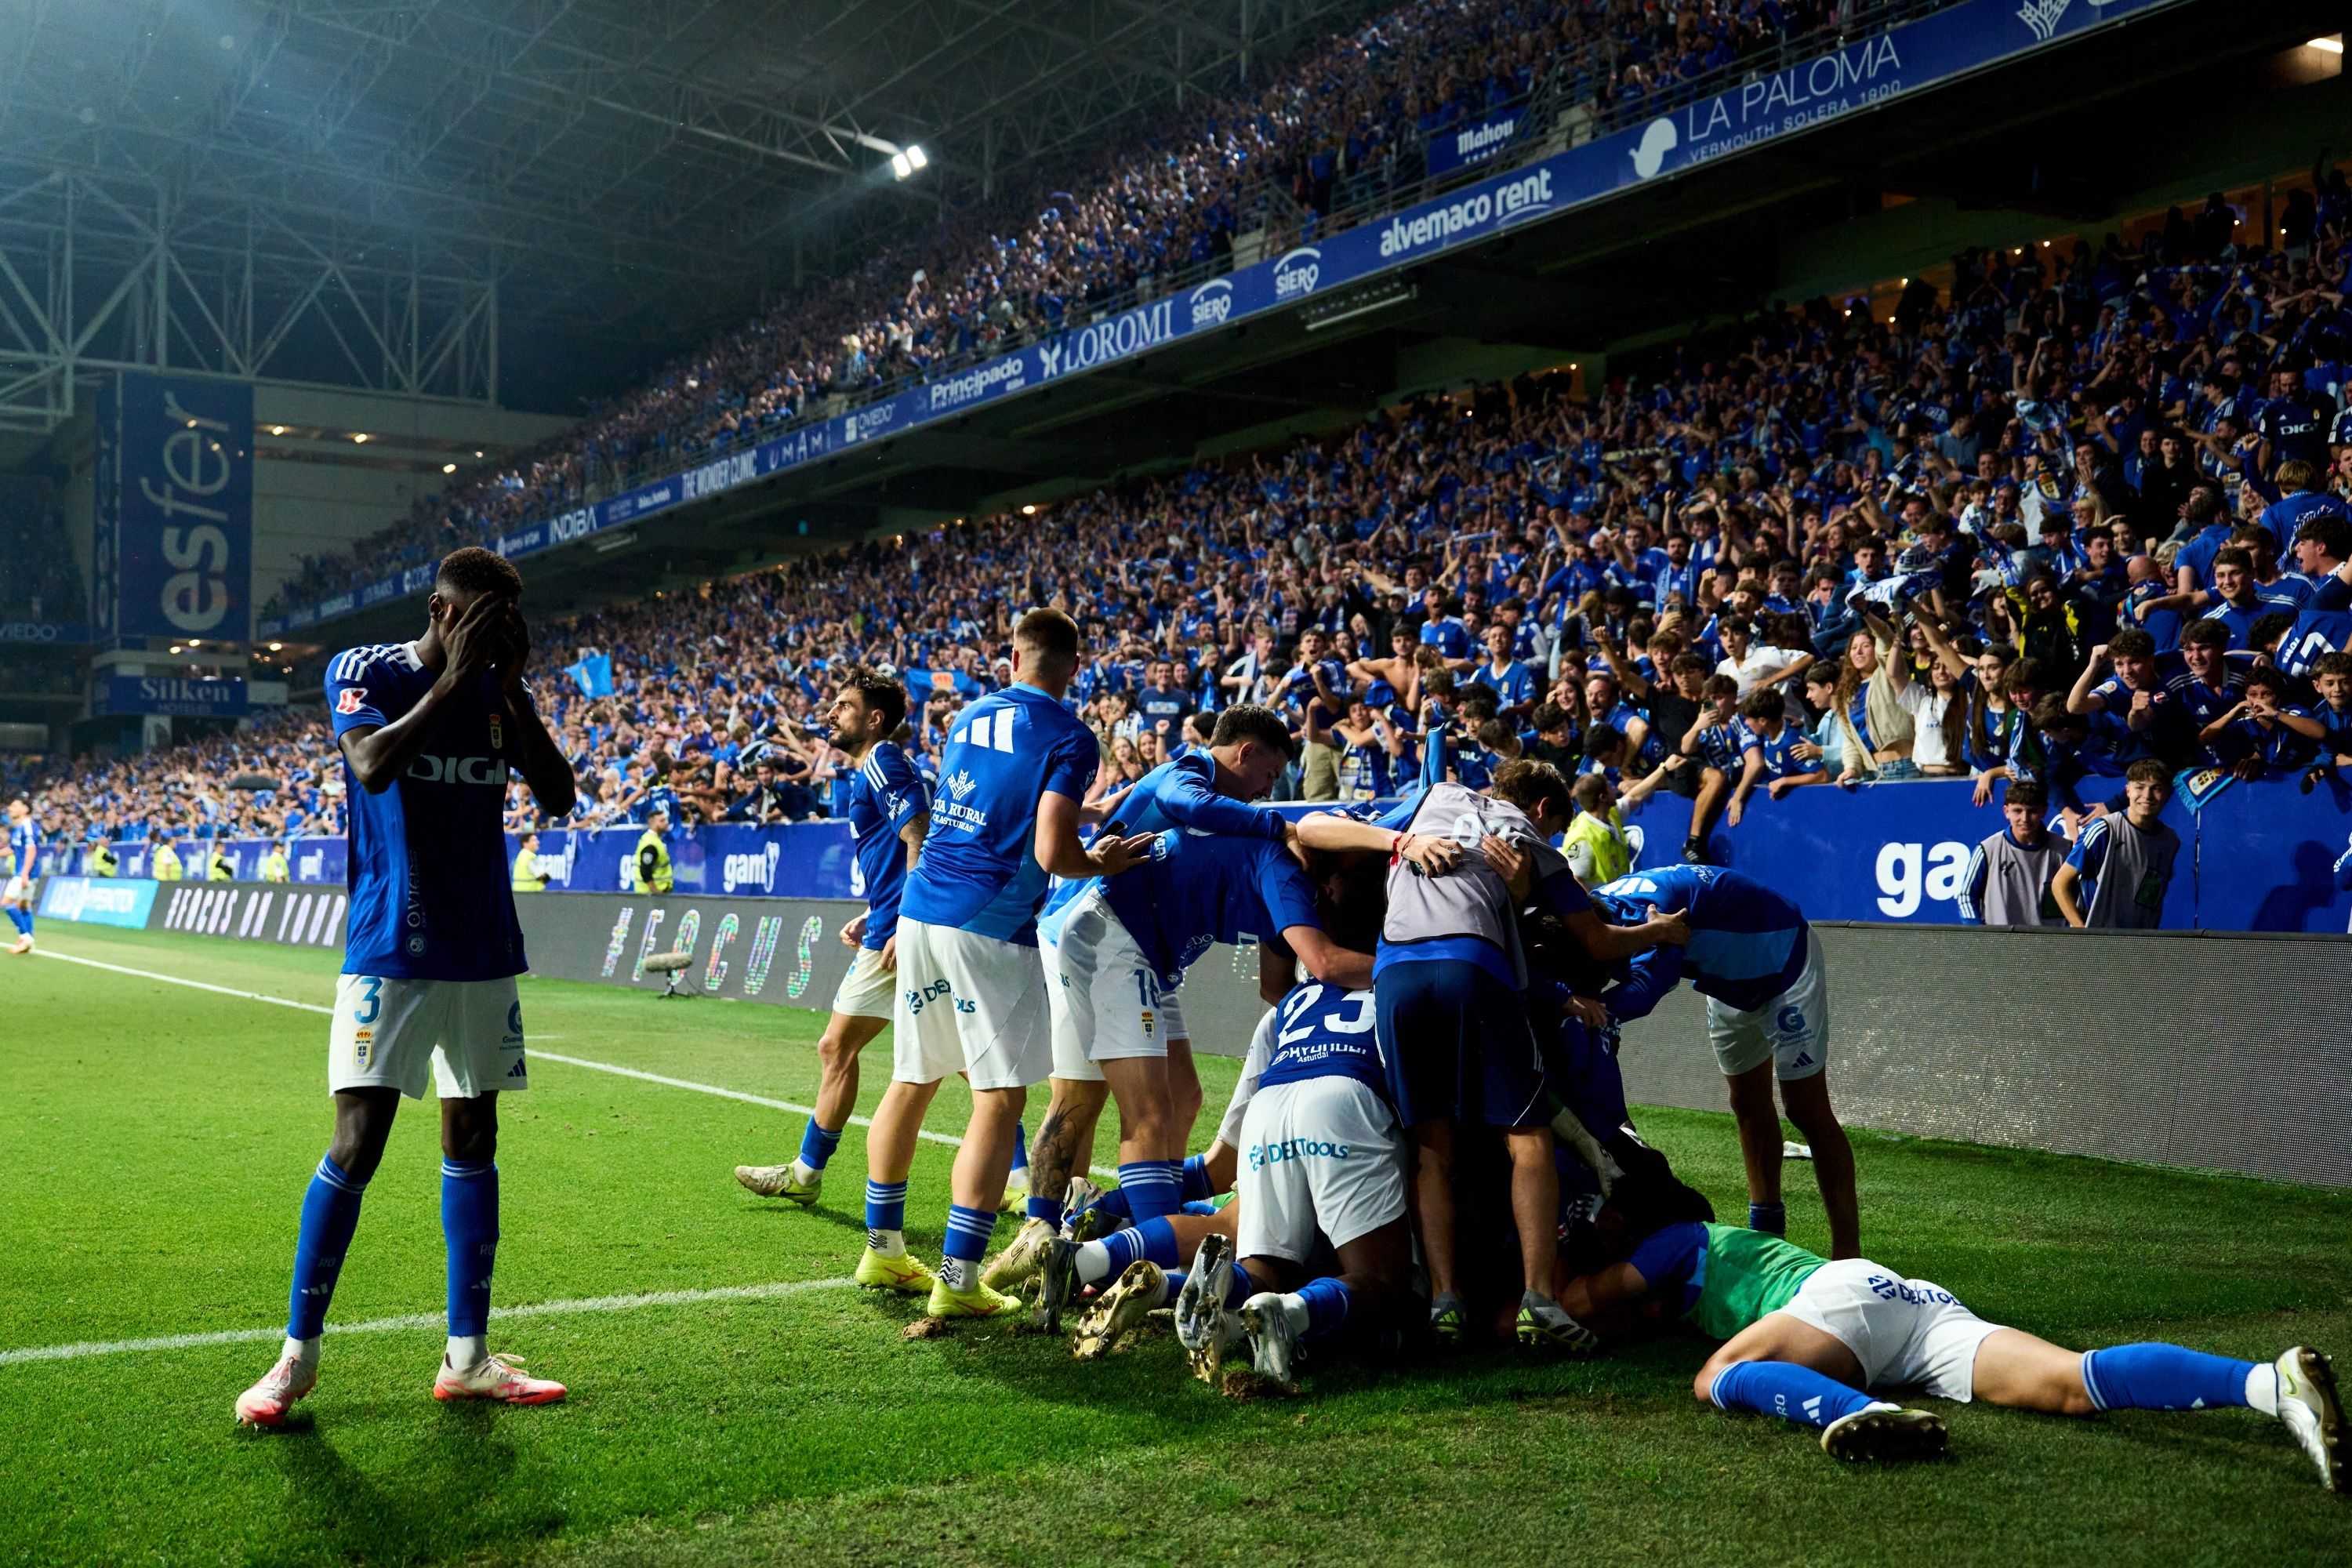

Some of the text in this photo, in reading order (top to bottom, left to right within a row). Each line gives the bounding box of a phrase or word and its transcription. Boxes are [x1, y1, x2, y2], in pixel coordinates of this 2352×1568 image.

[1690, 34, 1901, 142] LA PALOMA
[1690, 80, 1901, 162] VERMOUTH SOLERA 1900
[1380, 168, 1552, 256] alvemaco rent
[1063, 299, 1174, 372] LOROMI
[931, 358, 1024, 404] Principado
[140, 390, 230, 632] esfer
[550, 506, 597, 544] INDIBA
[0, 622, 57, 641] IEDO
[141, 677, 230, 702] Silken
[948, 802, 987, 826] RURAL
[723, 854, 767, 893] gam
[1876, 841, 1973, 918] ga
[354, 976, 383, 1024] 3
[1268, 1138, 1348, 1163] DEXTOOLS
